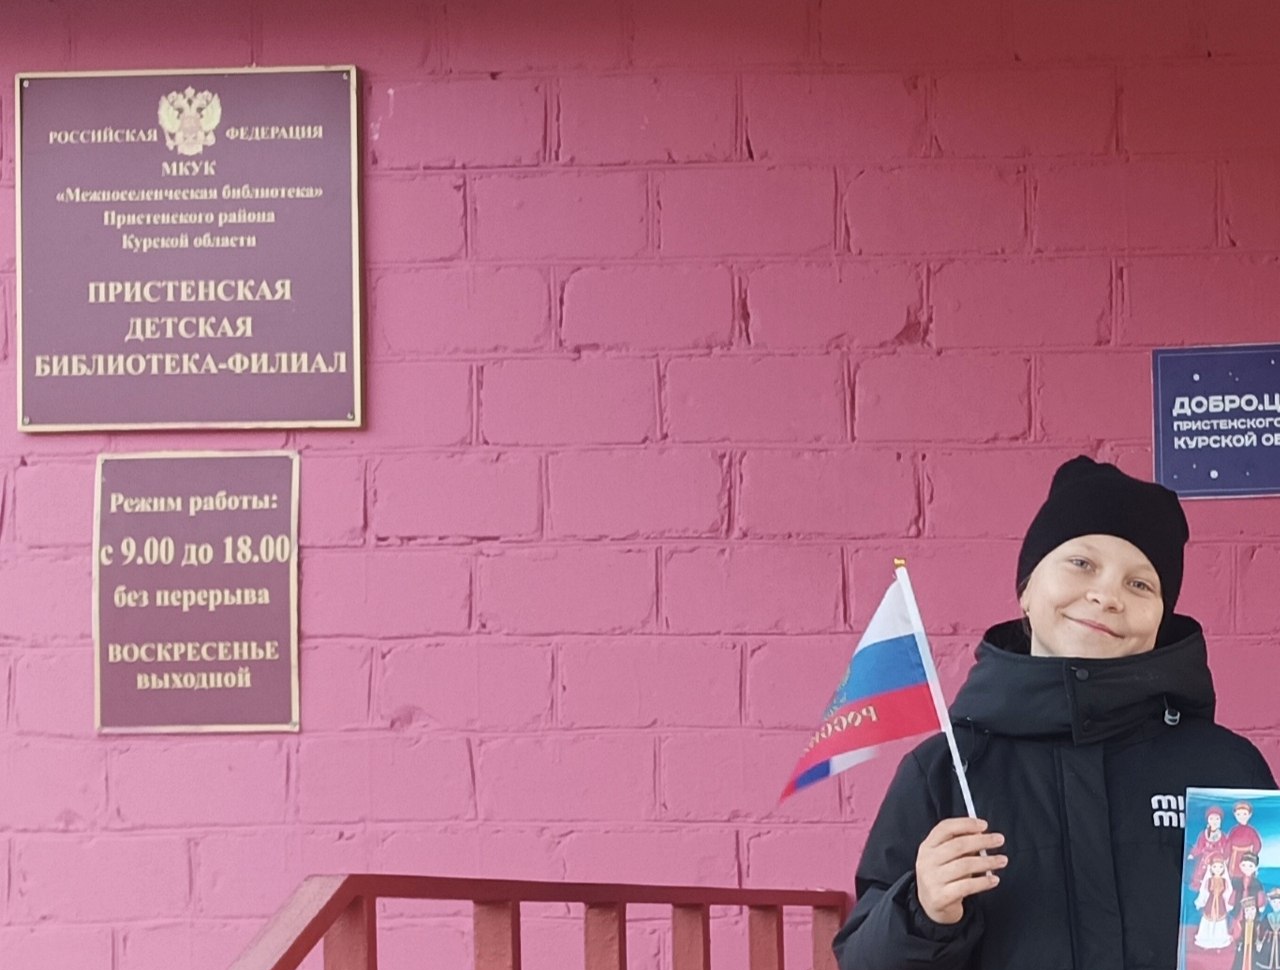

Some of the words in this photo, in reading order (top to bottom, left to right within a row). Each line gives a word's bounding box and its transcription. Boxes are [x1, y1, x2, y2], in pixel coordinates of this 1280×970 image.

[49, 126, 158, 144] РОССИЙСКАЯ
[225, 125, 323, 142] ФЕДЕРАЦИЯ
[161, 161, 216, 176] МКУК
[222, 184, 323, 201] библиотека»
[103, 210, 214, 229] Пристенского
[218, 208, 275, 227] района
[122, 234, 189, 252] Курской
[193, 232, 256, 248] области
[88, 279, 292, 303] ПРИСТЕНСКАЯ
[125, 316, 252, 342] ДЕТСКАЯ
[35, 352, 347, 377] БИБЛИОТЕКА-ФИЛИАЛ
[1174, 432, 1257, 449] КУРСКОЙ
[110, 493, 182, 513] Режим
[189, 490, 278, 516] работы:
[101, 546, 113, 565] с
[120, 536, 175, 565] 9.00
[181, 543, 213, 567] до
[223, 534, 289, 564] 18.00
[113, 585, 149, 608] без
[155, 587, 270, 612] перерыва
[108, 641, 279, 663] ВОСКРЕСЕНЬЕ
[136, 666, 252, 690] выходной
[1151, 795, 1185, 811] mi
[1153, 811, 1186, 828] mi
